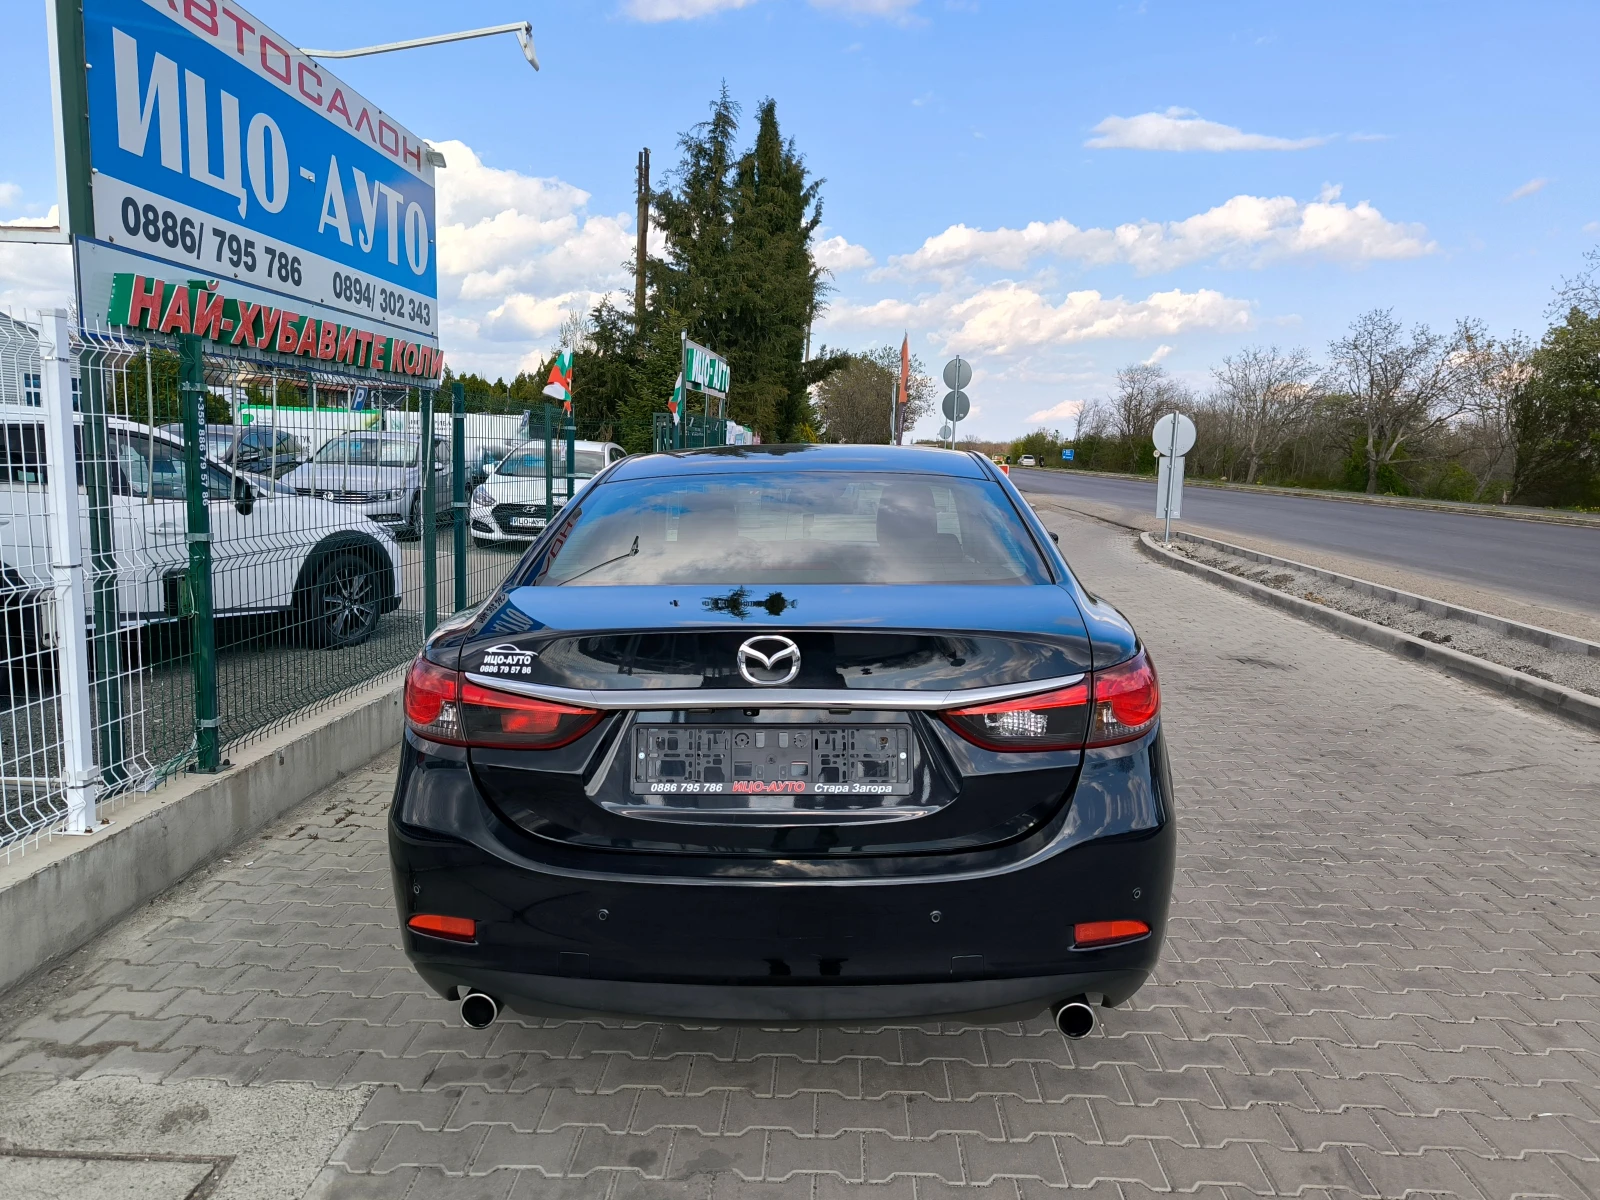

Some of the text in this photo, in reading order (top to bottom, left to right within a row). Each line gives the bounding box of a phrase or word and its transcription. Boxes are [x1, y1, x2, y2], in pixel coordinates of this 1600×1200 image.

[167, 0, 421, 172] ВТОСАЛОН
[112, 26, 429, 276] ИЦО-АУТО
[121, 196, 302, 287] 0886/ 795 786
[128, 274, 444, 380] НАЙ-ХУБАВИТЕ КОЛИ
[333, 271, 431, 326] 0894/ 302 343
[353, 389, 365, 409] P
[197, 395, 209, 507] +359 886 79 57 86
[480, 665, 532, 674] 0886 79 57 86
[483, 655, 532, 665] ИЦО-АУТО
[650, 780, 893, 794] 0886 795 786 ИЦО-АУТО Стара Загора
